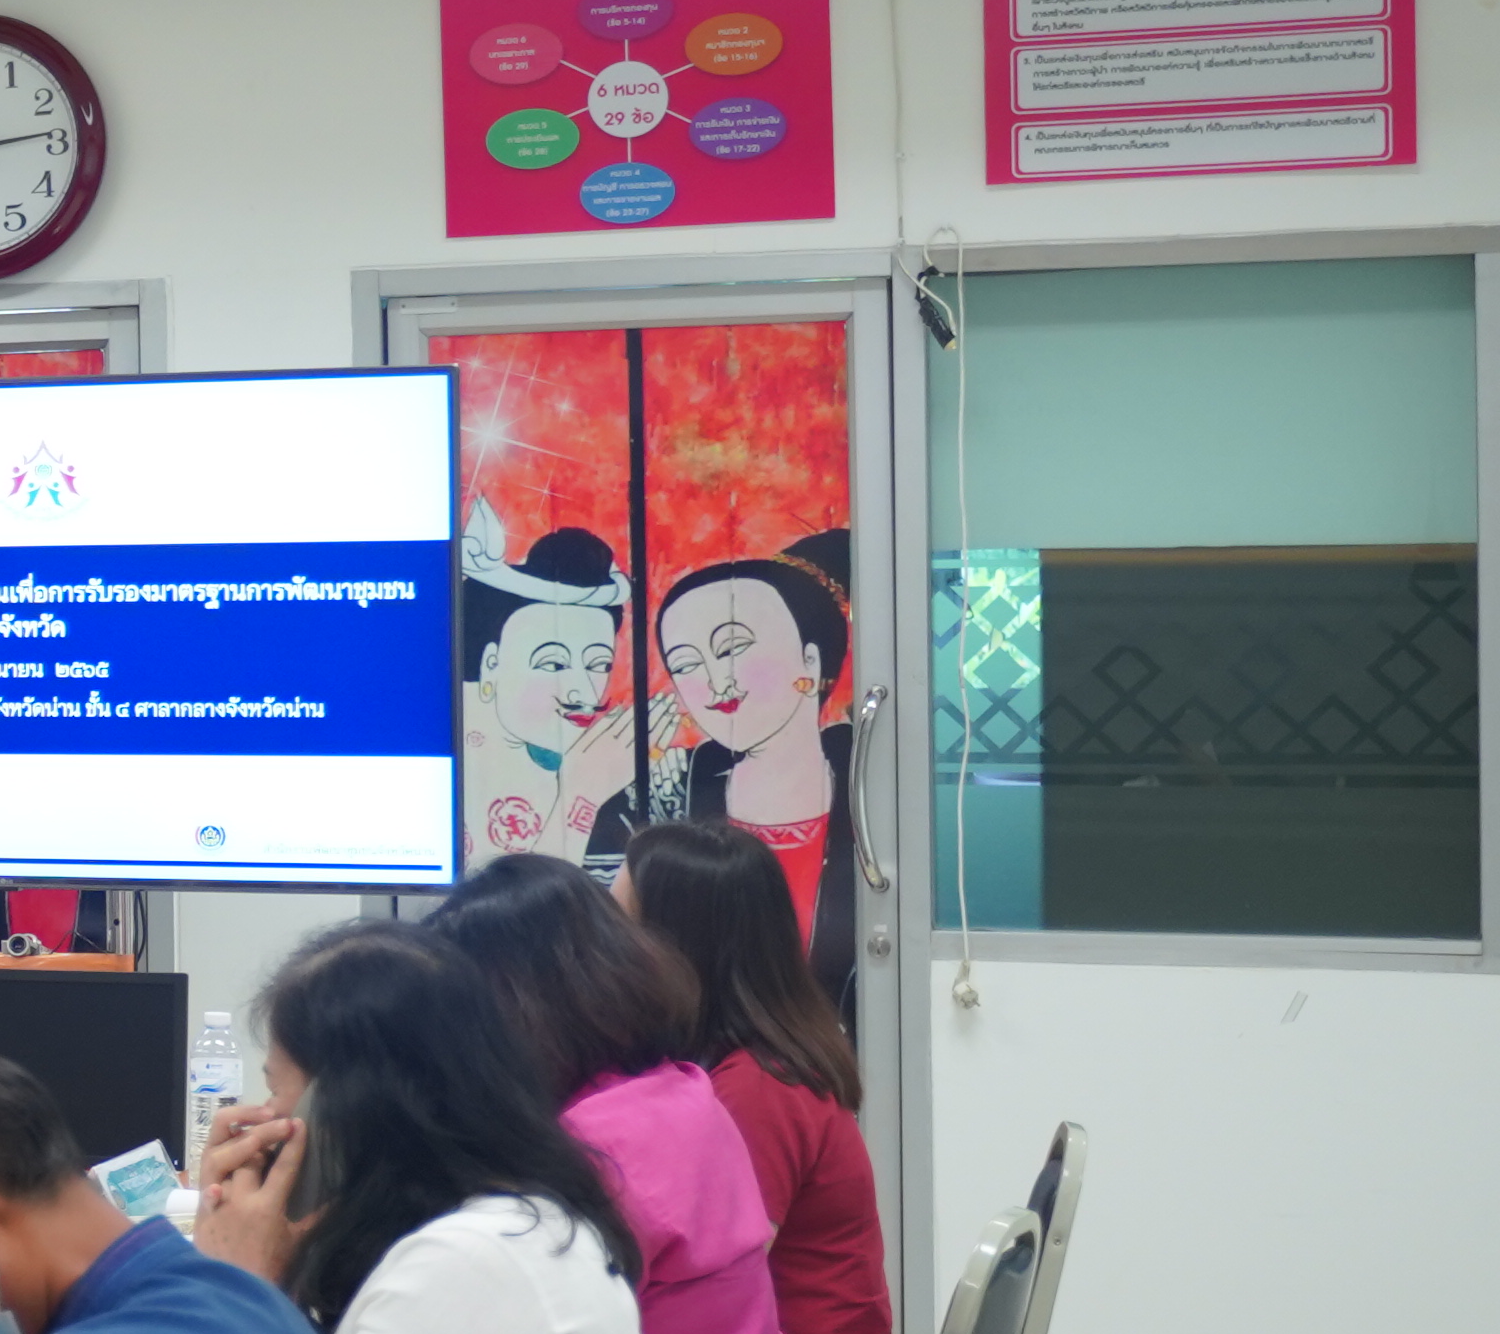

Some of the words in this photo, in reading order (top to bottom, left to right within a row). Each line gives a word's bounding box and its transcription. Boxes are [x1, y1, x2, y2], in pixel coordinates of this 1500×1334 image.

[4, 61, 18, 89] 1
[34, 88, 54, 116] 2
[597, 84, 607, 97] 6
[614, 81, 659, 97] หมวด
[604, 112, 625, 126] 29
[632, 107, 654, 125] ข้อ
[46, 128, 70, 155] 3
[31, 171, 55, 197] 4
[3, 203, 26, 231] 5
[85, 690, 111, 718] ชั้น
[134, 695, 325, 719] ศาลากลางจังหวัดน่าน
